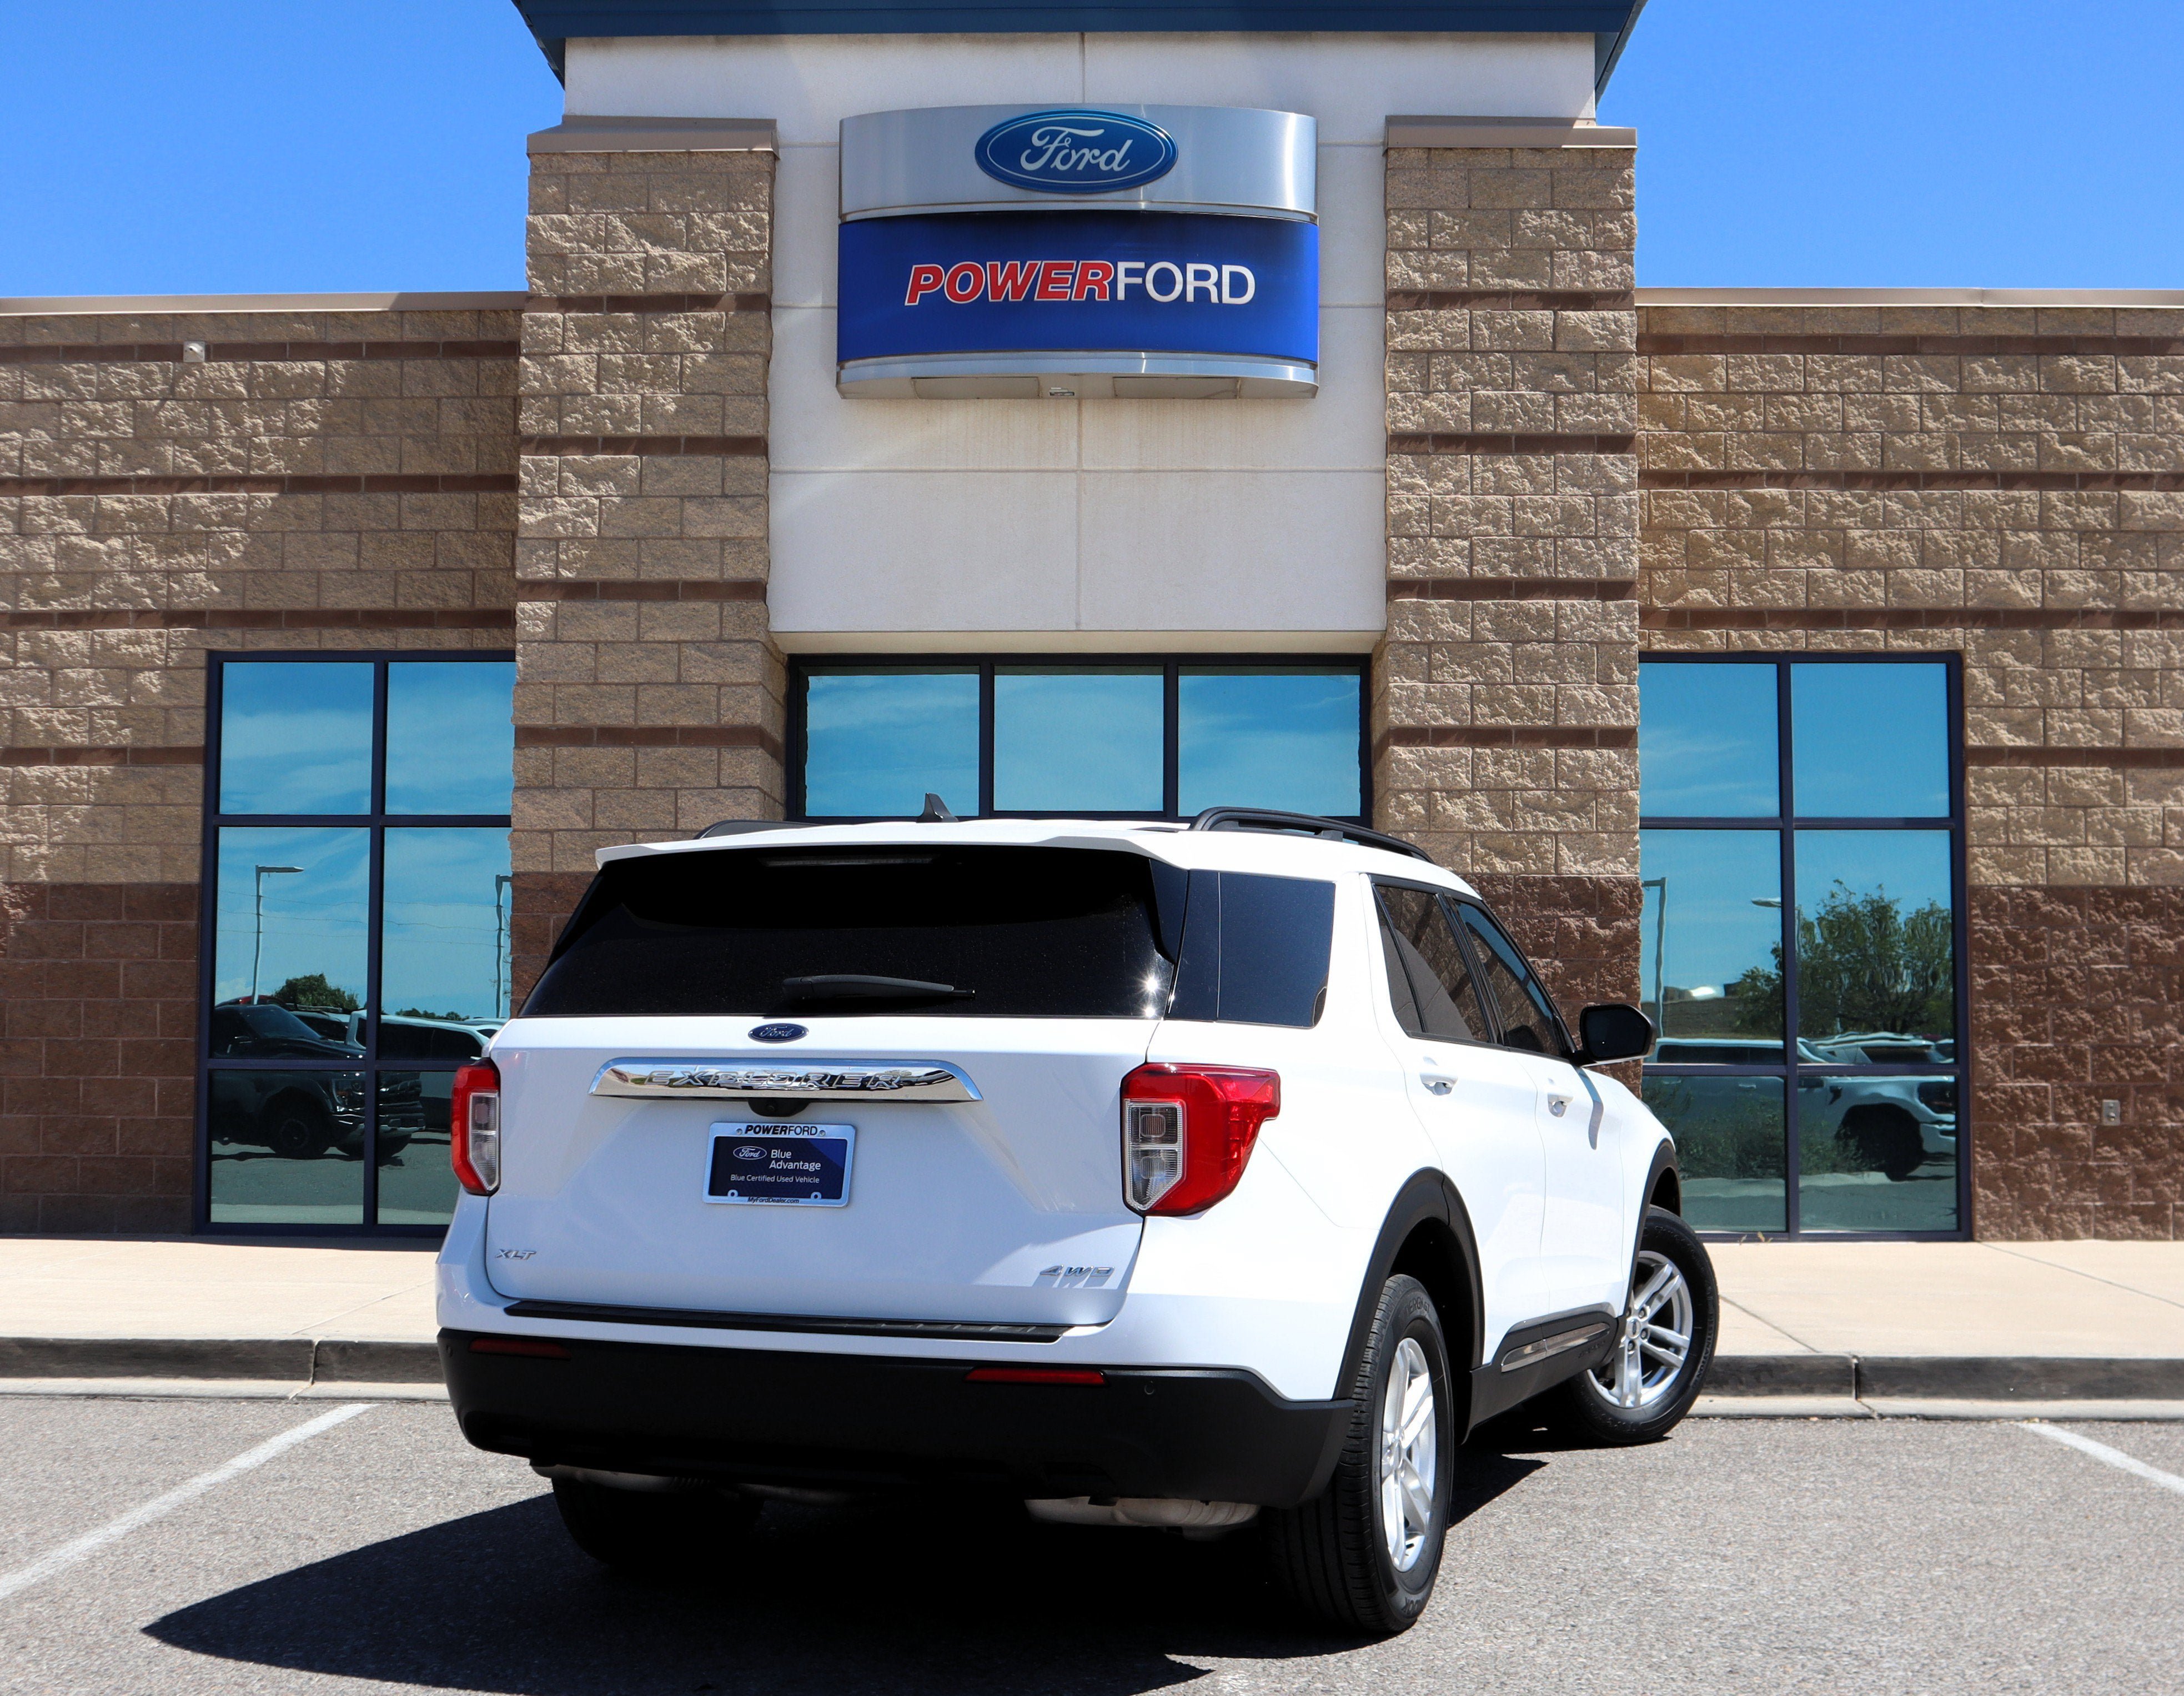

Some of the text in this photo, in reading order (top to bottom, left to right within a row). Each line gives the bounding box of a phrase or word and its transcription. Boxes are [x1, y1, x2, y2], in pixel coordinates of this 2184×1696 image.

[1020, 126, 1133, 173] Ford
[904, 259, 1256, 306] POWERFORD
[759, 1025, 795, 1037] Ford
[644, 1070, 902, 1090] EXPLORER
[744, 1125, 818, 1136] POWERFORD
[739, 1147, 761, 1159] Ford
[771, 1149, 792, 1159] Blue
[769, 1160, 821, 1172] Advantage
[495, 1248, 537, 1260] XLT
[1040, 1264, 1116, 1277] 4WD
